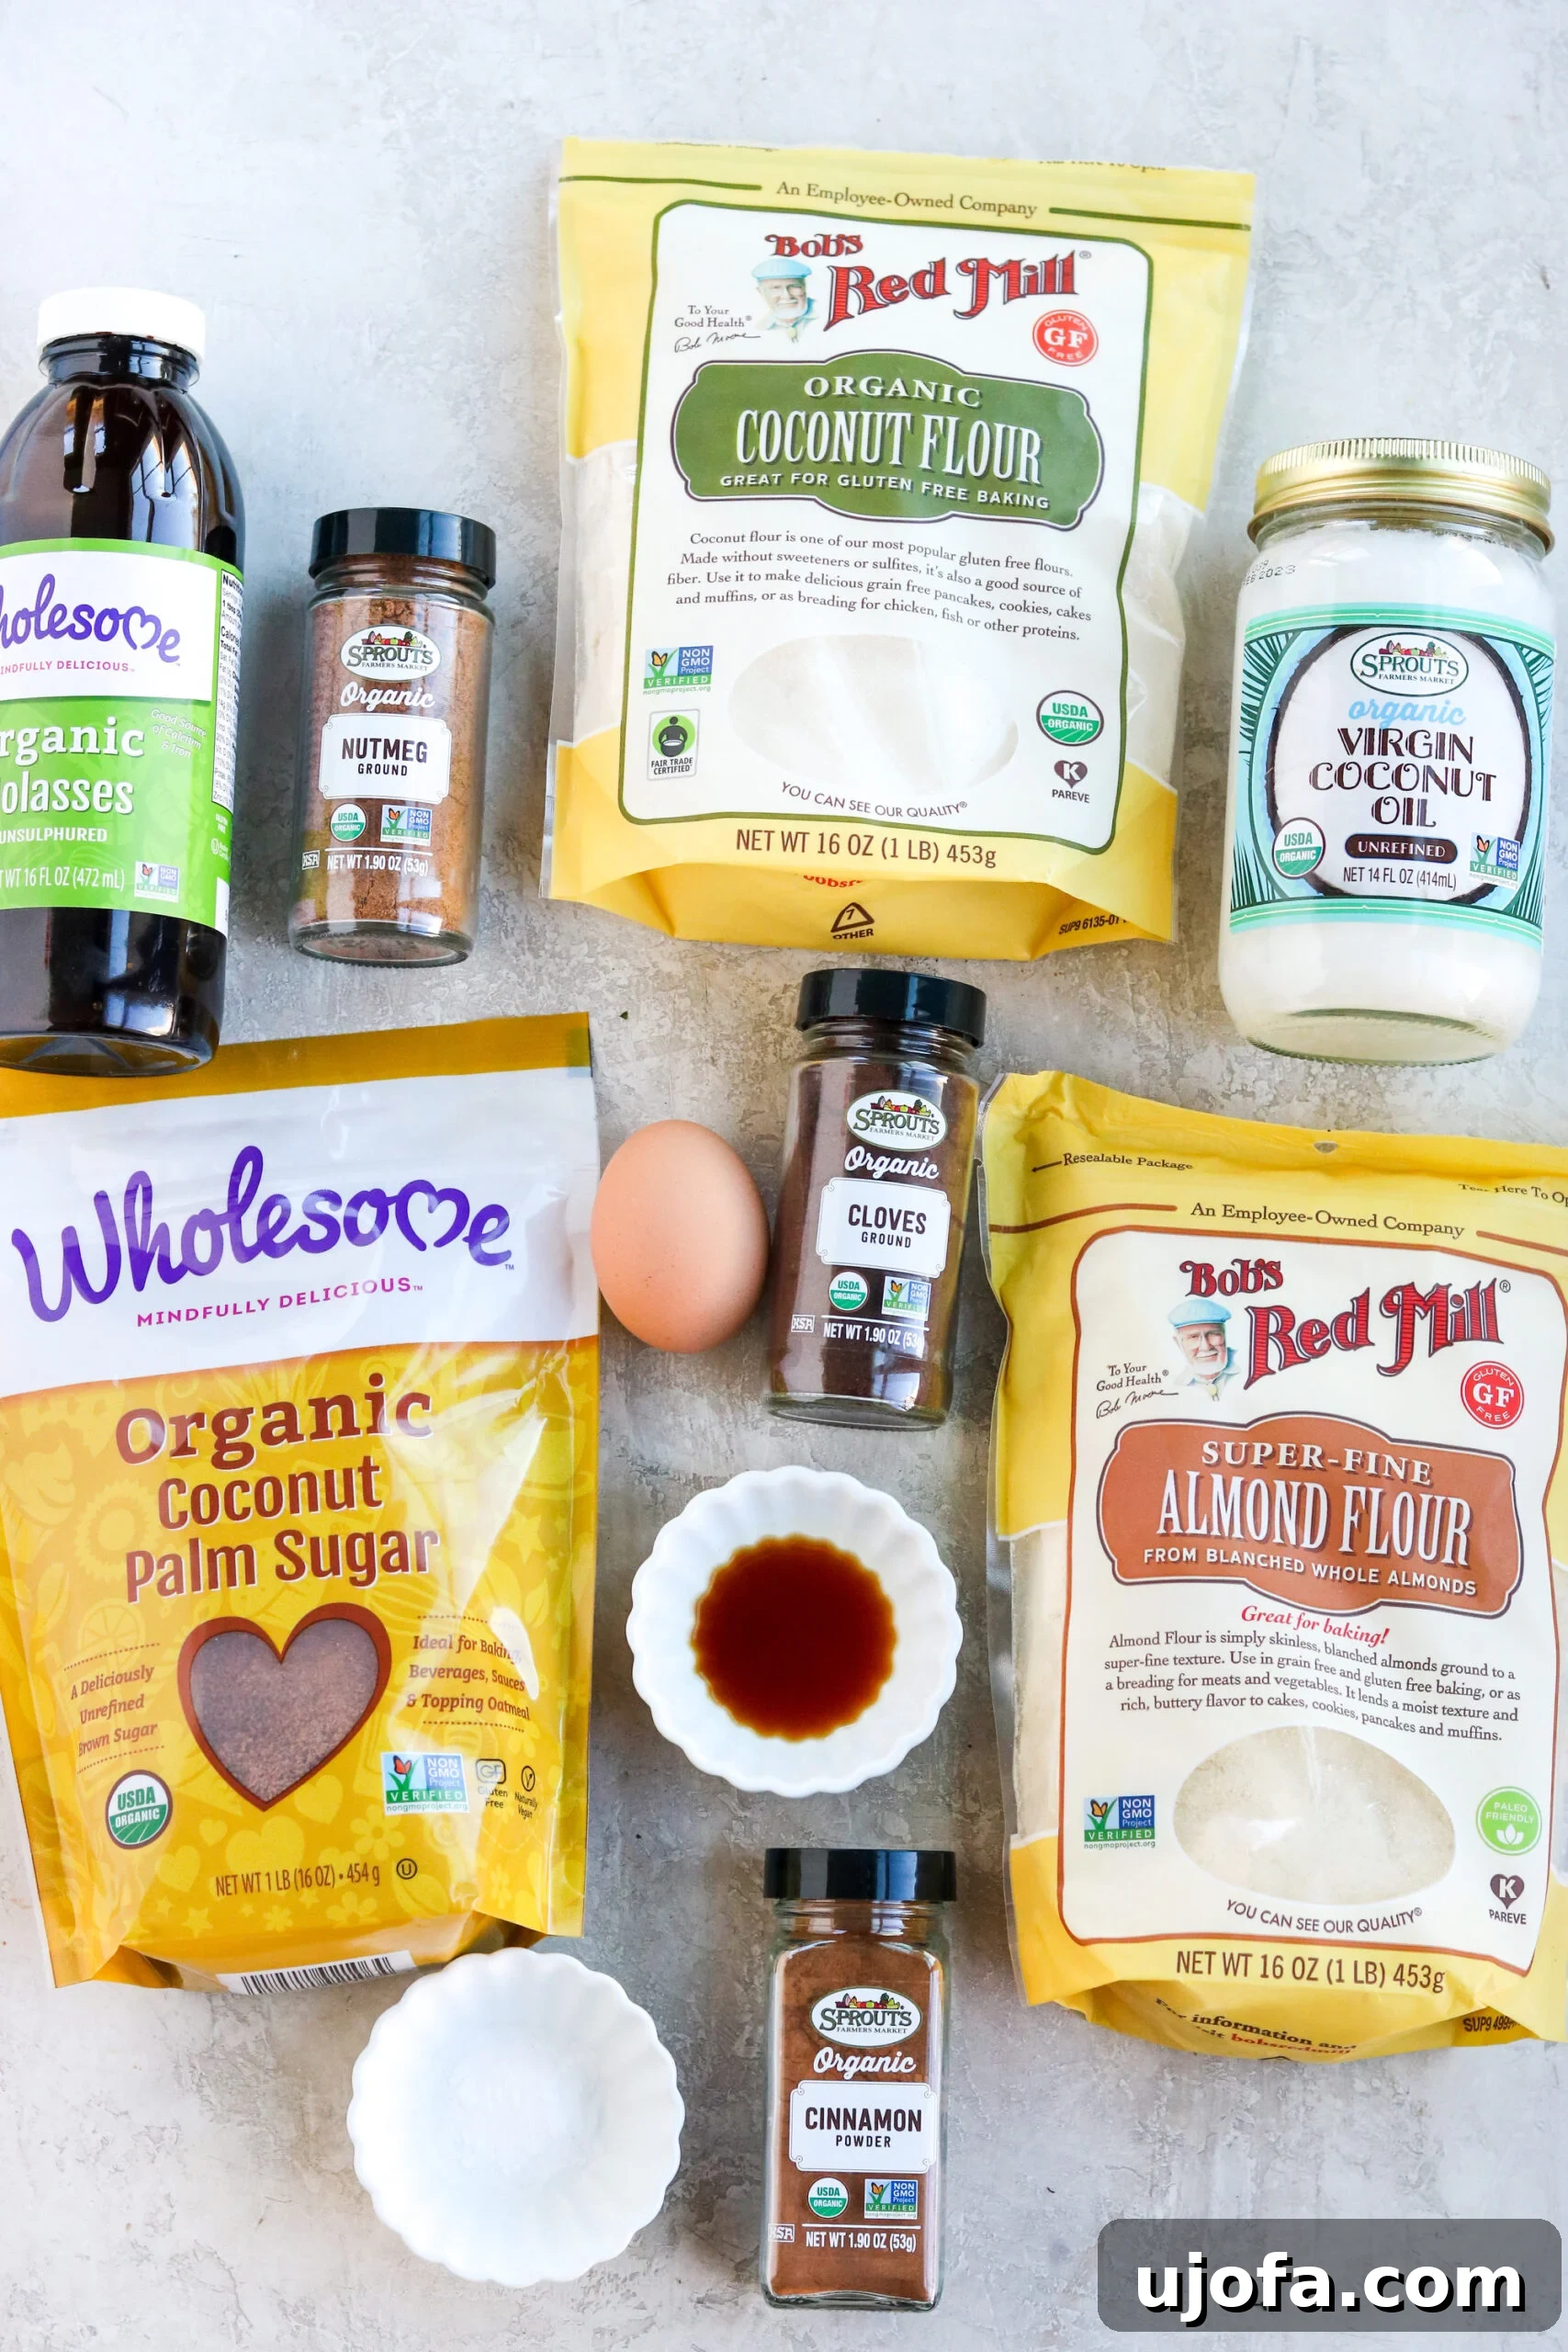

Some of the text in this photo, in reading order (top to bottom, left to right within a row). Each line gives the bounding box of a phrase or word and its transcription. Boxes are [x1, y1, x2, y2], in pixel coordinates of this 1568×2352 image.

[776, 181, 1037, 218] An Employee-Owned Company
[764, 233, 863, 258] Bob's
[823, 256, 953, 333] Red
[674, 317, 704, 328] Good
[688, 305, 729, 315] To Your
[1043, 327, 1088, 348] GF
[805, 376, 982, 409] ORGANIC
[738, 410, 1043, 485] COCONUT FLOUR
[720, 472, 1050, 510] GREAT FOR GLUTEN FREE BAKING
[690, 530, 1074, 577] Coconut flour is one of our most popular gluten free flours.
[0, 573, 180, 663] holesome
[346, 645, 433, 667] SPROUTS
[397, 662, 428, 671] MARKET
[682, 649, 709, 658] NON
[682, 658, 709, 667] GMO
[1360, 652, 1459, 678] SPROUTS
[0, 660, 52, 674] INDFULLY
[681, 667, 709, 675] Project
[1379, 674, 1455, 685] FARMERS MARKET
[648, 677, 707, 688] VERIFIED
[340, 682, 435, 712] Organic
[1053, 702, 1088, 718] USDA
[1048, 718, 1093, 731] ORGANIC
[1348, 698, 1466, 727] organic
[0, 716, 144, 766] rganic
[342, 738, 427, 763] NUTMEG
[1337, 727, 1473, 765] VIRGIN
[358, 763, 408, 776] GROUND
[1309, 762, 1497, 802] COCONUT
[1, 771, 134, 815] olasses
[1052, 789, 1090, 803] PAREVE
[1371, 796, 1437, 828] OIL
[0, 827, 107, 843] UNSULPHURED
[1358, 841, 1446, 858] UNREFINED
[6, 868, 21, 888] WT
[25, 868, 37, 888] 16
[39, 867, 51, 888] FL
[54, 866, 70, 888] OZ
[73, 866, 98, 888] (472
[102, 867, 125, 892] mL)
[1344, 867, 1362, 882] NET
[1369, 868, 1380, 882] 14
[1383, 869, 1396, 883] FL
[1400, 869, 1413, 884] OZ
[1416, 872, 1457, 890] (414mL)
[852, 1107, 940, 1136] SPROUTS
[844, 1145, 940, 1180] Organic
[1064, 1152, 1193, 1170] Resealable Package
[848, 1204, 927, 1235] CLOVES
[1190, 1202, 1465, 1239] An Employee-Owned Company
[11, 1146, 512, 1323] Wholesome
[862, 1231, 911, 1249] GROUND
[1179, 1258, 1284, 1297] Bob's
[138, 1297, 270, 1327] MINDFULLY
[1242, 1286, 1375, 1390] Red
[1472, 1365, 1515, 1387] GLUTEN
[1473, 1381, 1514, 1409] GF
[116, 1372, 434, 1470] Organic
[1475, 1405, 1511, 1423] FREE
[1201, 1441, 1432, 1486] SUPER-FINE
[158, 1455, 383, 1530] Coconut
[1156, 1468, 1472, 1567] ALMOND FLOUR
[126, 1529, 440, 1603] Palm Sugar
[1144, 1547, 1476, 1596] FROM BLANCHED WHOLE ALMONDS
[1242, 1605, 1390, 1647] Great for baking!
[1110, 1630, 1516, 1679] Almond Flour is simply skinless, blanched almonds ground to a
[71, 1665, 154, 1700] A Deliciously
[80, 1693, 145, 1724] Unrefined
[79, 1724, 158, 1758] Brown Sugar
[118, 1786, 155, 1811] USDA
[1122, 1799, 1151, 1809] NON
[1494, 1802, 1529, 1813] PALEO
[116, 1808, 160, 1828] ORGANIC
[1122, 1808, 1152, 1819] GMO
[1122, 1819, 1151, 1828] Project
[1485, 1812, 1534, 1824] FRIENDLY
[1089, 1829, 1152, 1840] VERIFIED
[1227, 1899, 1257, 1920] YOU
[1260, 1910, 1292, 1929] CAN
[1296, 1917, 1319, 1932] SEE
[1324, 1919, 1353, 1934] OUR
[1488, 1908, 1527, 1925] PAREVE
[1178, 1950, 1445, 1994] NET WT 16 OZ (1 LB) 453g
[819, 2008, 912, 2030] SPROUTS
[837, 2026, 872, 2034] FARMERS
[814, 2046, 917, 2080] Organic
[806, 2107, 922, 2132] CINNAMON
[836, 2135, 891, 2148] POWDER
[807, 2232, 916, 2252] NET WT 1.90 OZ (53g)
